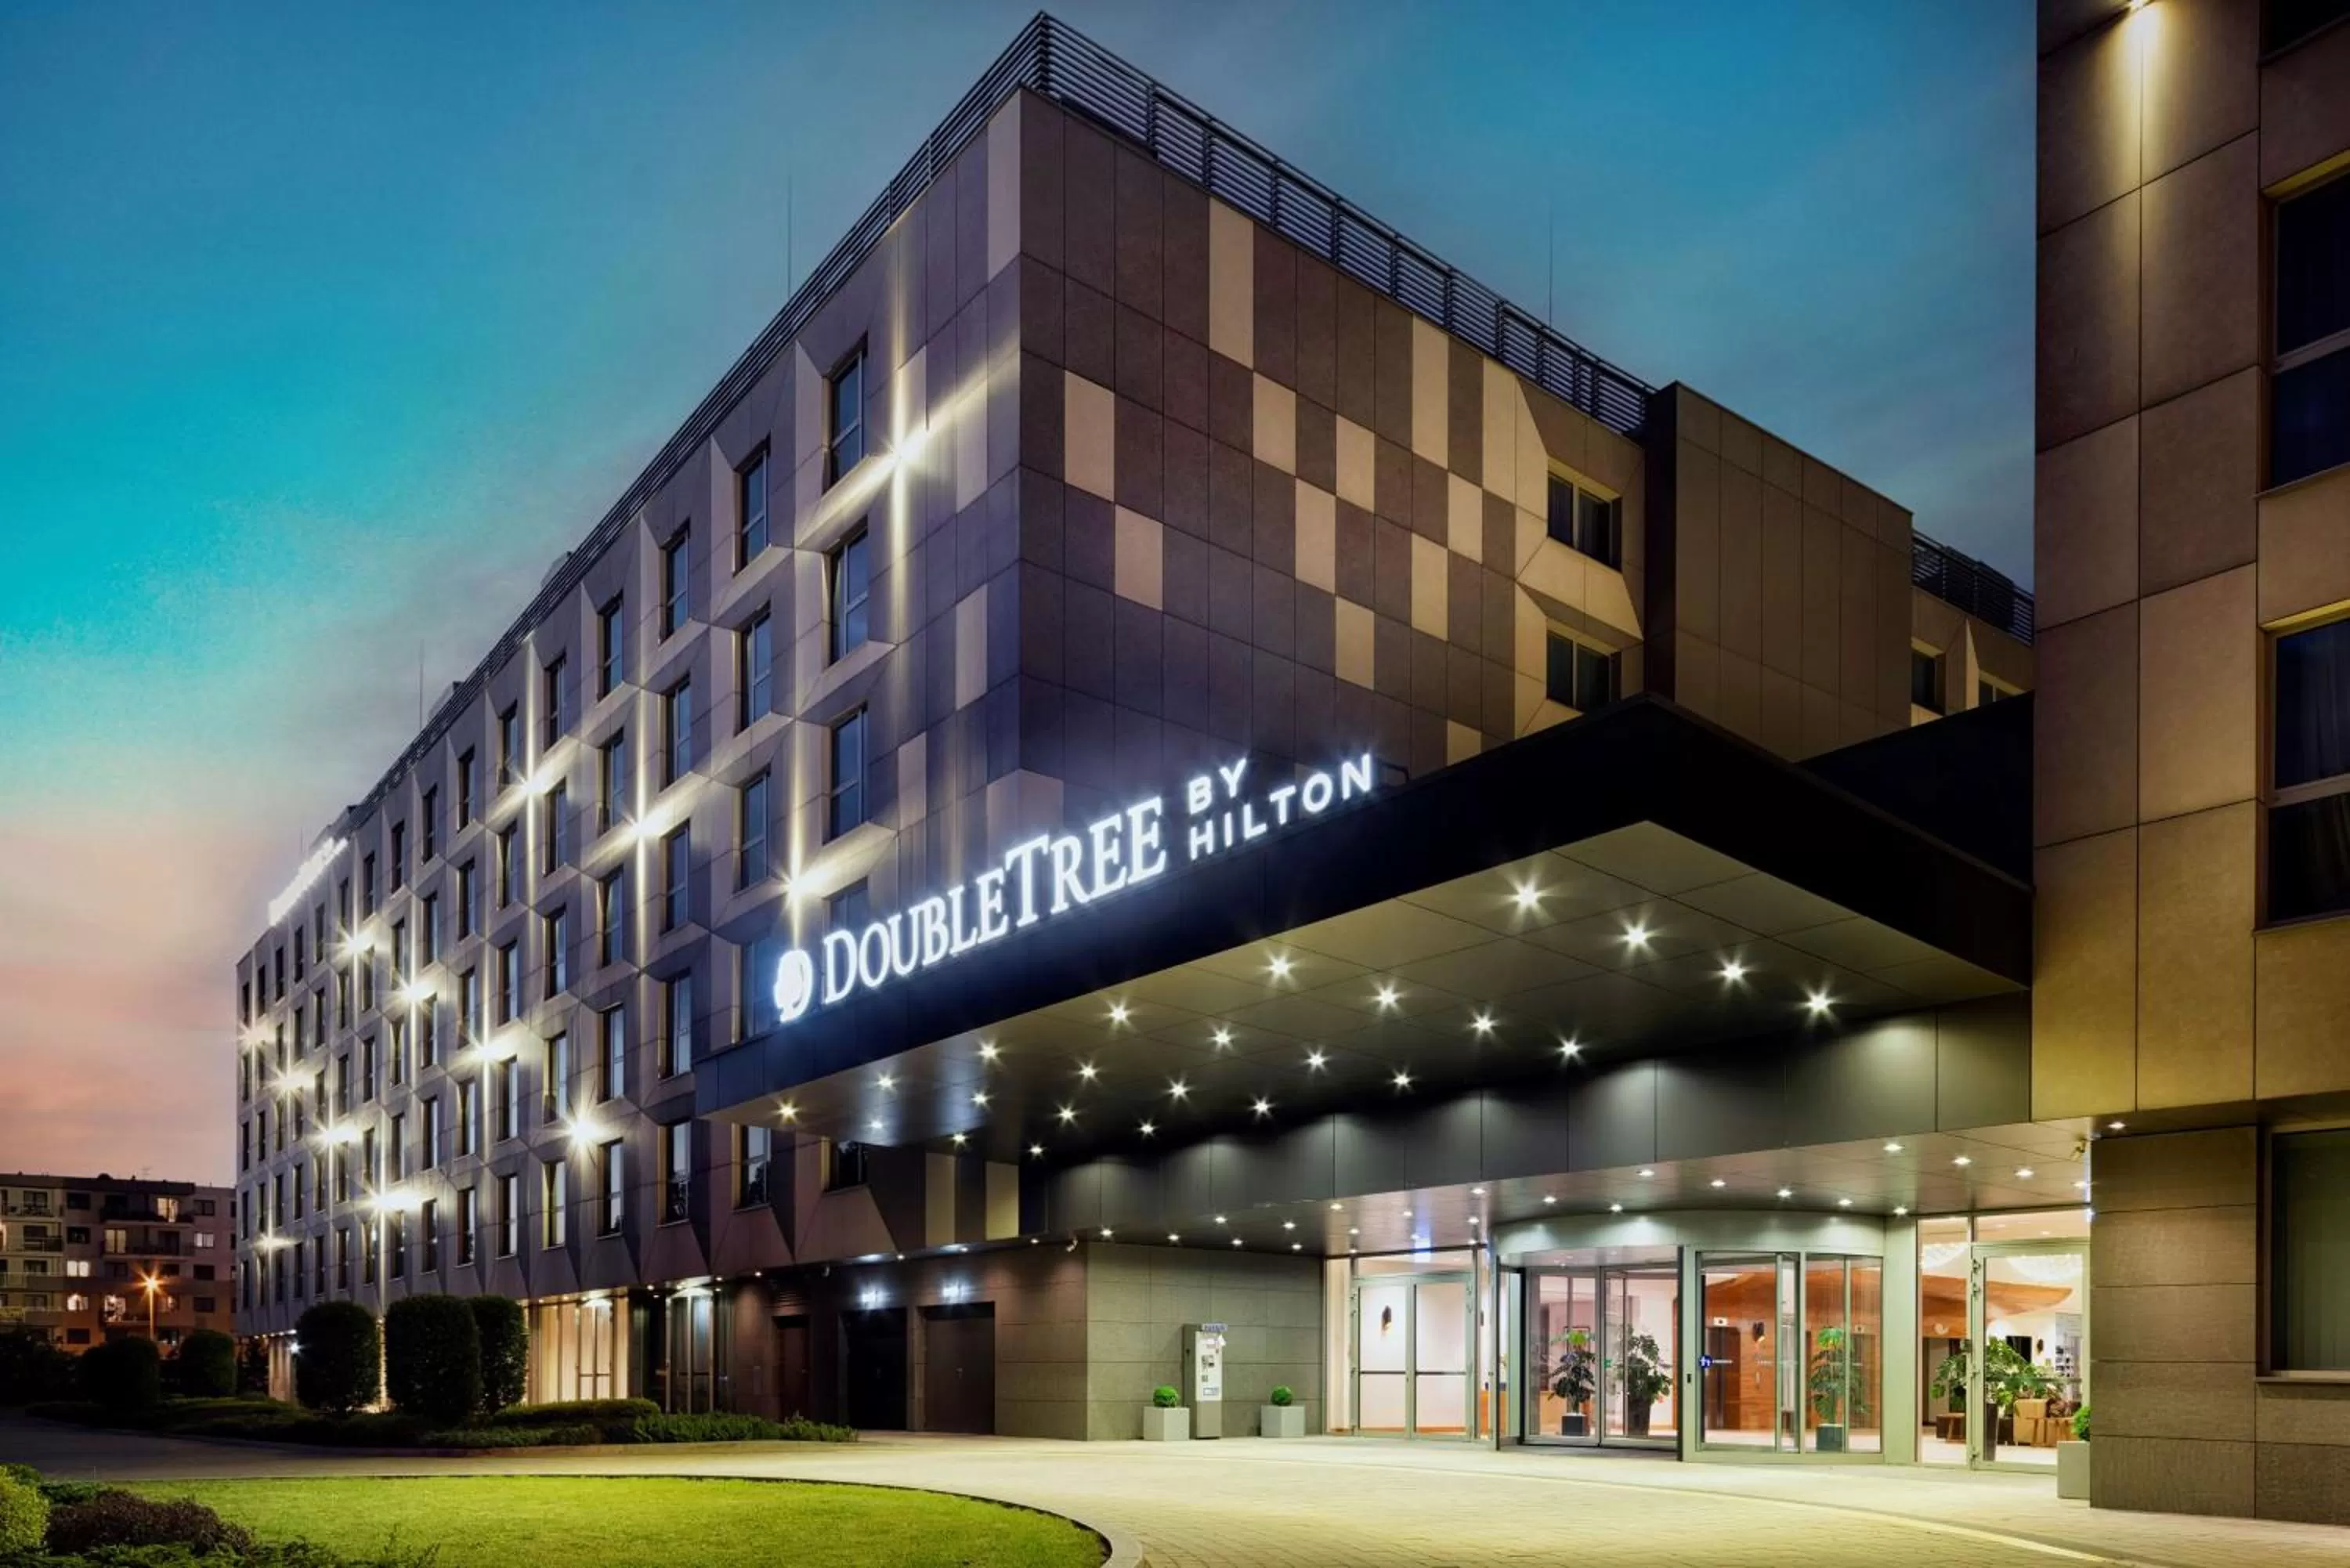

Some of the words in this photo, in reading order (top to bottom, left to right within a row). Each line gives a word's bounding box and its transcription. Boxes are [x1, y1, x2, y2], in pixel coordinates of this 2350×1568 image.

[1188, 757, 1247, 815] BY
[1189, 753, 1372, 861] HILTON
[822, 796, 1167, 1005] DOUBLETREE
